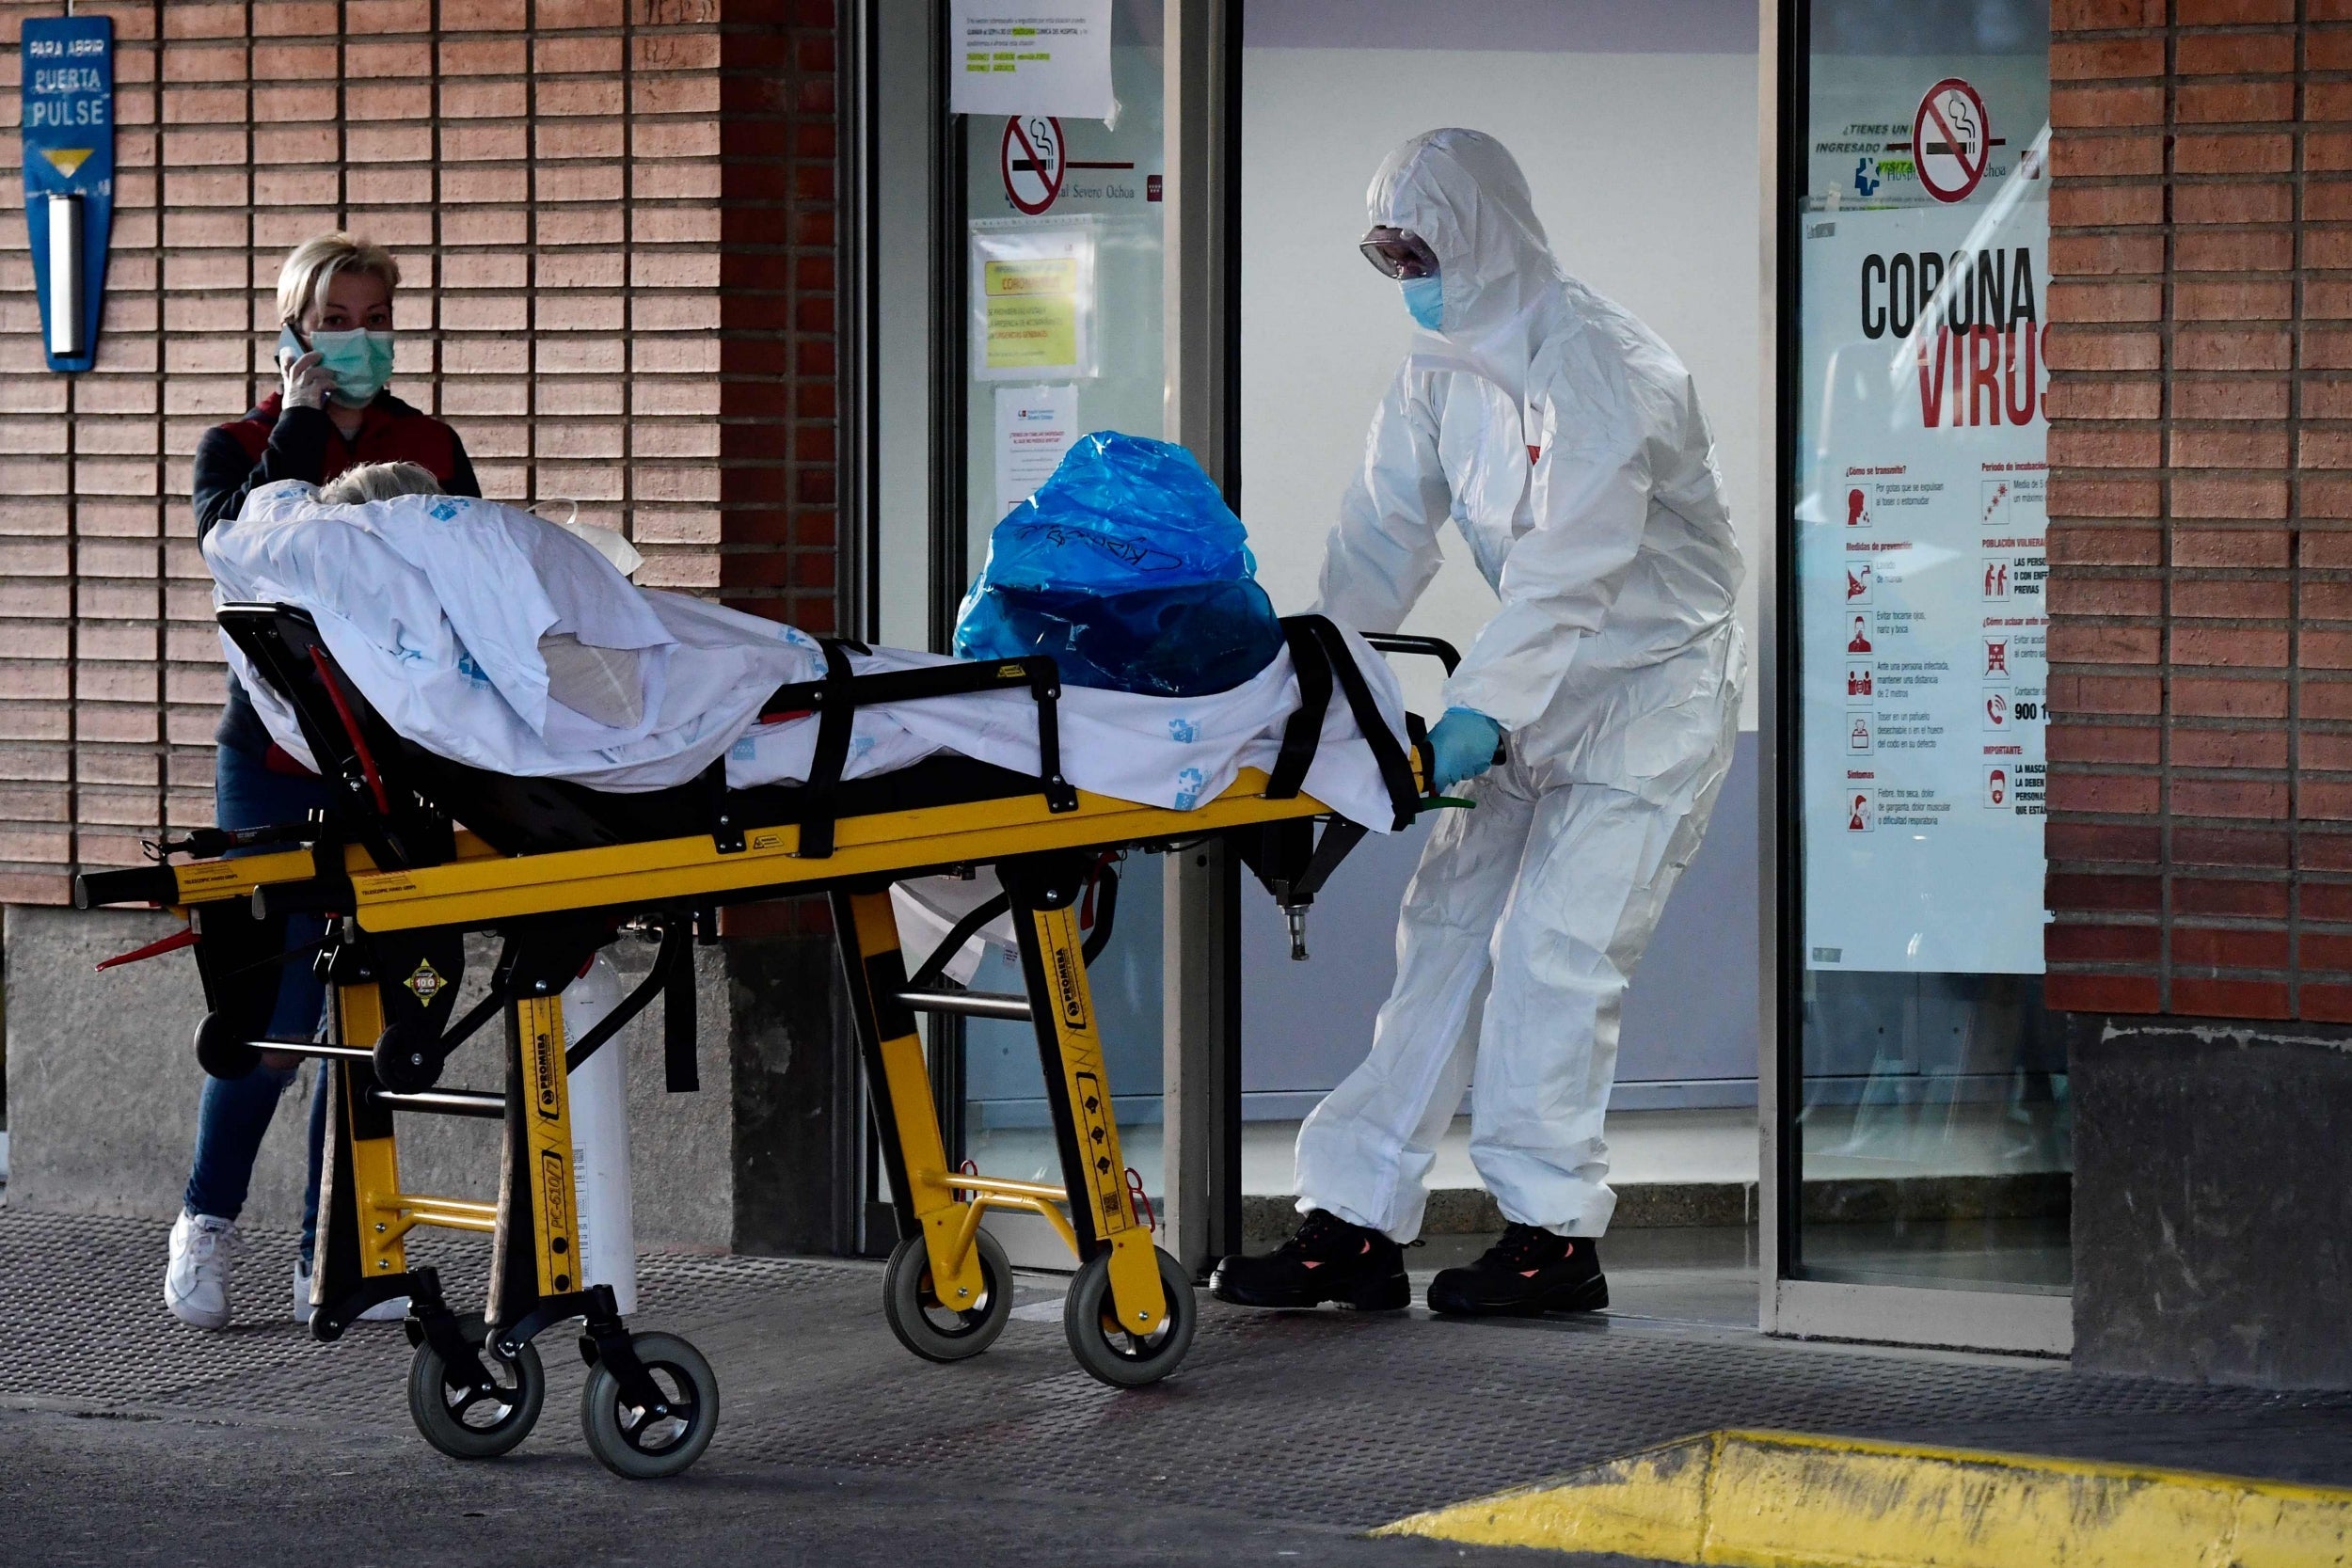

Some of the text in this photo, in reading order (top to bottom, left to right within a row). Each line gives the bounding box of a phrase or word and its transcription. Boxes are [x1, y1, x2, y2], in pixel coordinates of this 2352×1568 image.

[30, 39, 104, 56] PARA ABRIR
[35, 68, 102, 91] PUERTA
[33, 100, 103, 127] PULSE
[1843, 124, 1908, 135] ¿TIENES UN
[1816, 143, 1880, 152] INGRESADO
[1073, 184, 1103, 199] Severo
[1106, 183, 1135, 199] Ochoa
[1861, 247, 2038, 340] CORONA
[1981, 462, 2004, 471] Periodo
[2014, 558, 2025, 566] LAS
[2020, 571, 2031, 580] CON
[2014, 585, 2039, 594] PREVIAS
[1901, 663, 1922, 673] persona
[2014, 687, 2040, 696] Contactar
[2014, 703, 2037, 720] 900
[1983, 746, 2023, 754] IMPORTANTE:
[2015, 765, 2023, 773] LA
[2015, 778, 2044, 787] LA DEBEN
[2015, 806, 2027, 815] QUE
[1055, 947, 1073, 1002] PROMEBA
[416, 978, 426, 987] 10
[537, 1034, 548, 1089] PROMEBA
[544, 1161, 564, 1229] PC-610/7
